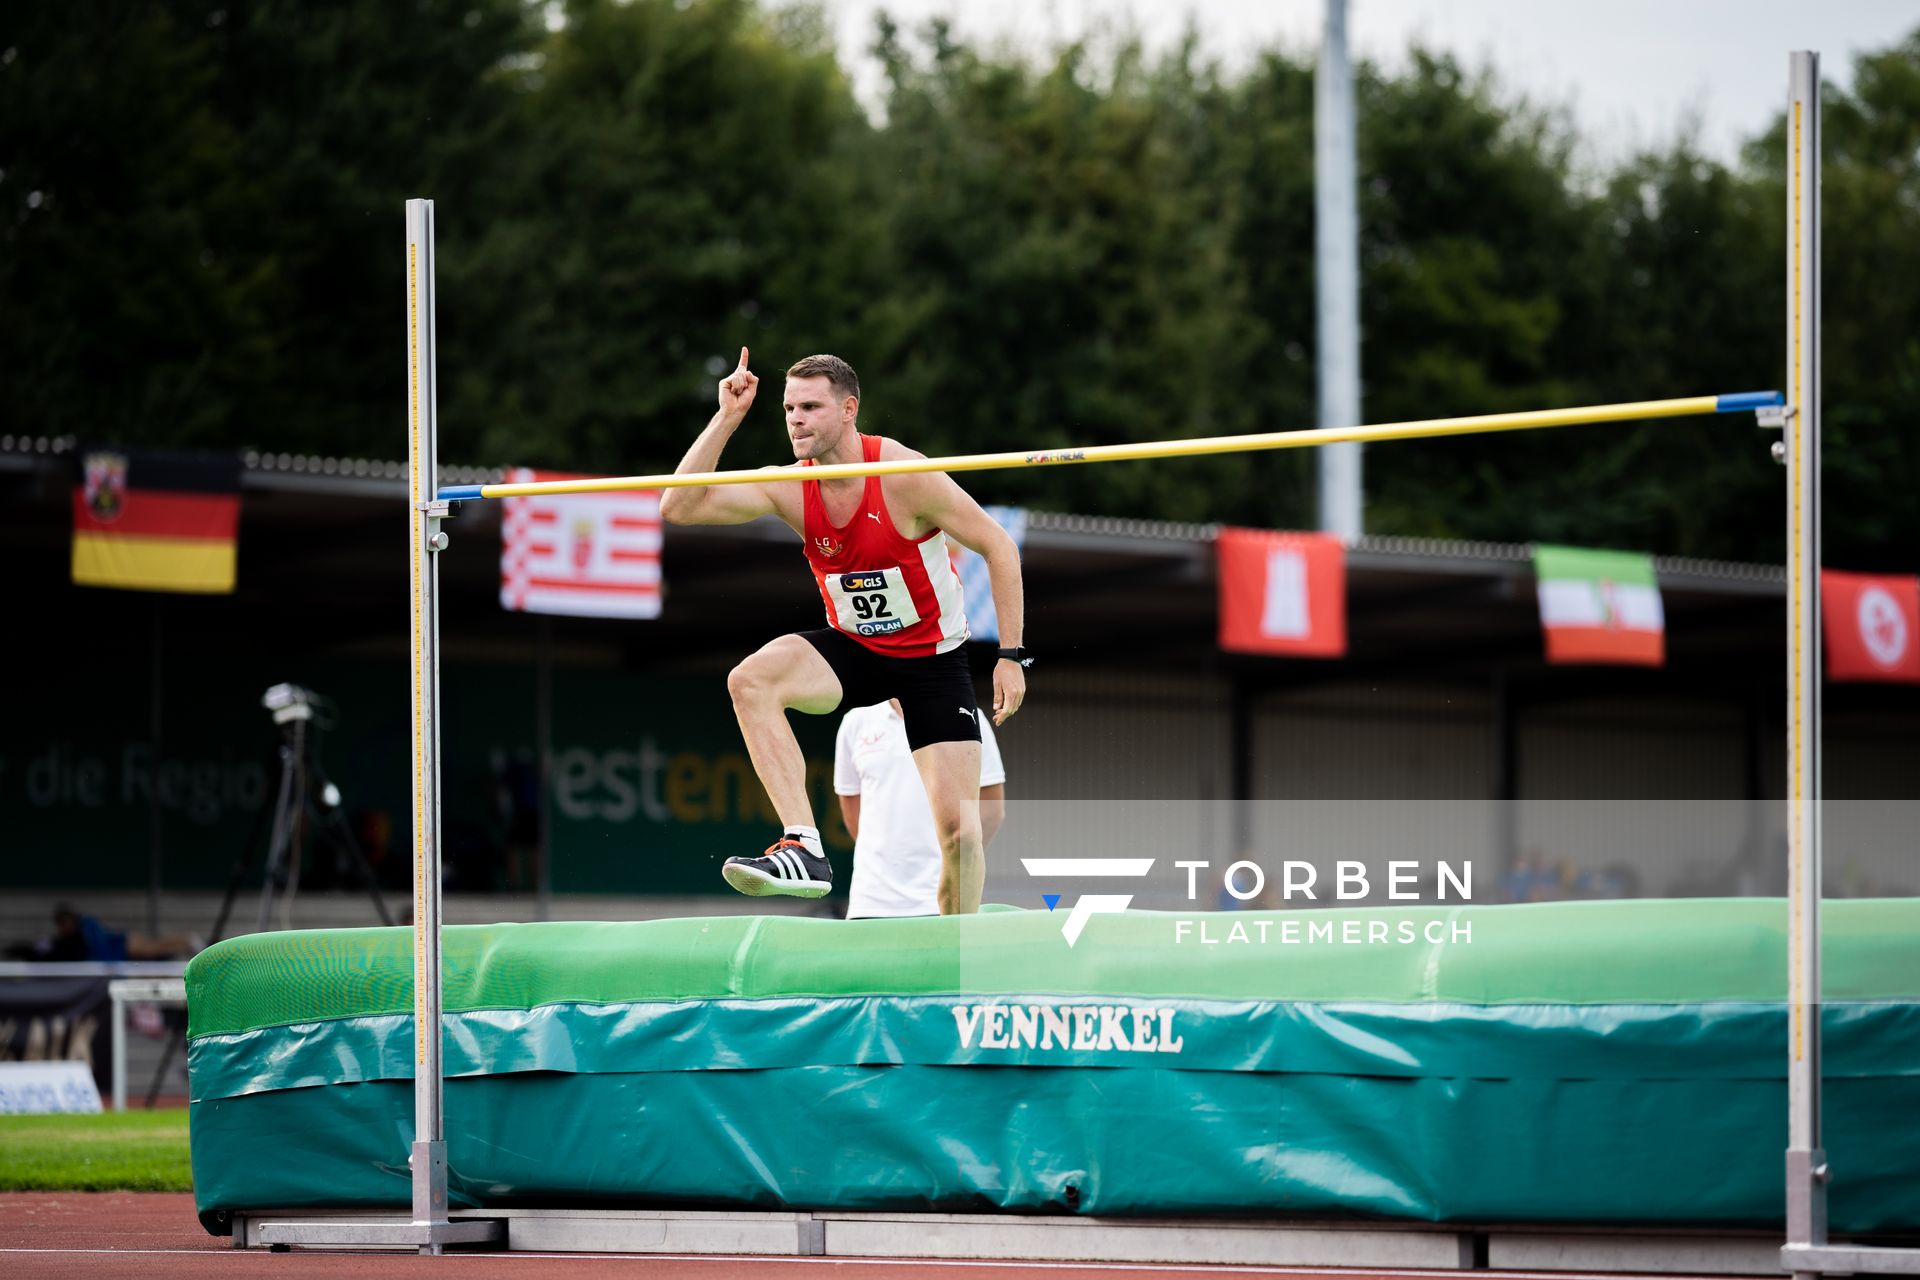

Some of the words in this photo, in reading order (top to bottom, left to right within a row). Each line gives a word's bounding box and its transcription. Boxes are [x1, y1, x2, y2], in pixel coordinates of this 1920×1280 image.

[863, 577, 882, 589] GLS
[852, 593, 893, 620] 92
[874, 621, 901, 632] PLAN
[25, 740, 101, 808] die
[121, 740, 268, 824] Regio
[951, 1004, 1184, 1054] VENNEKEL
